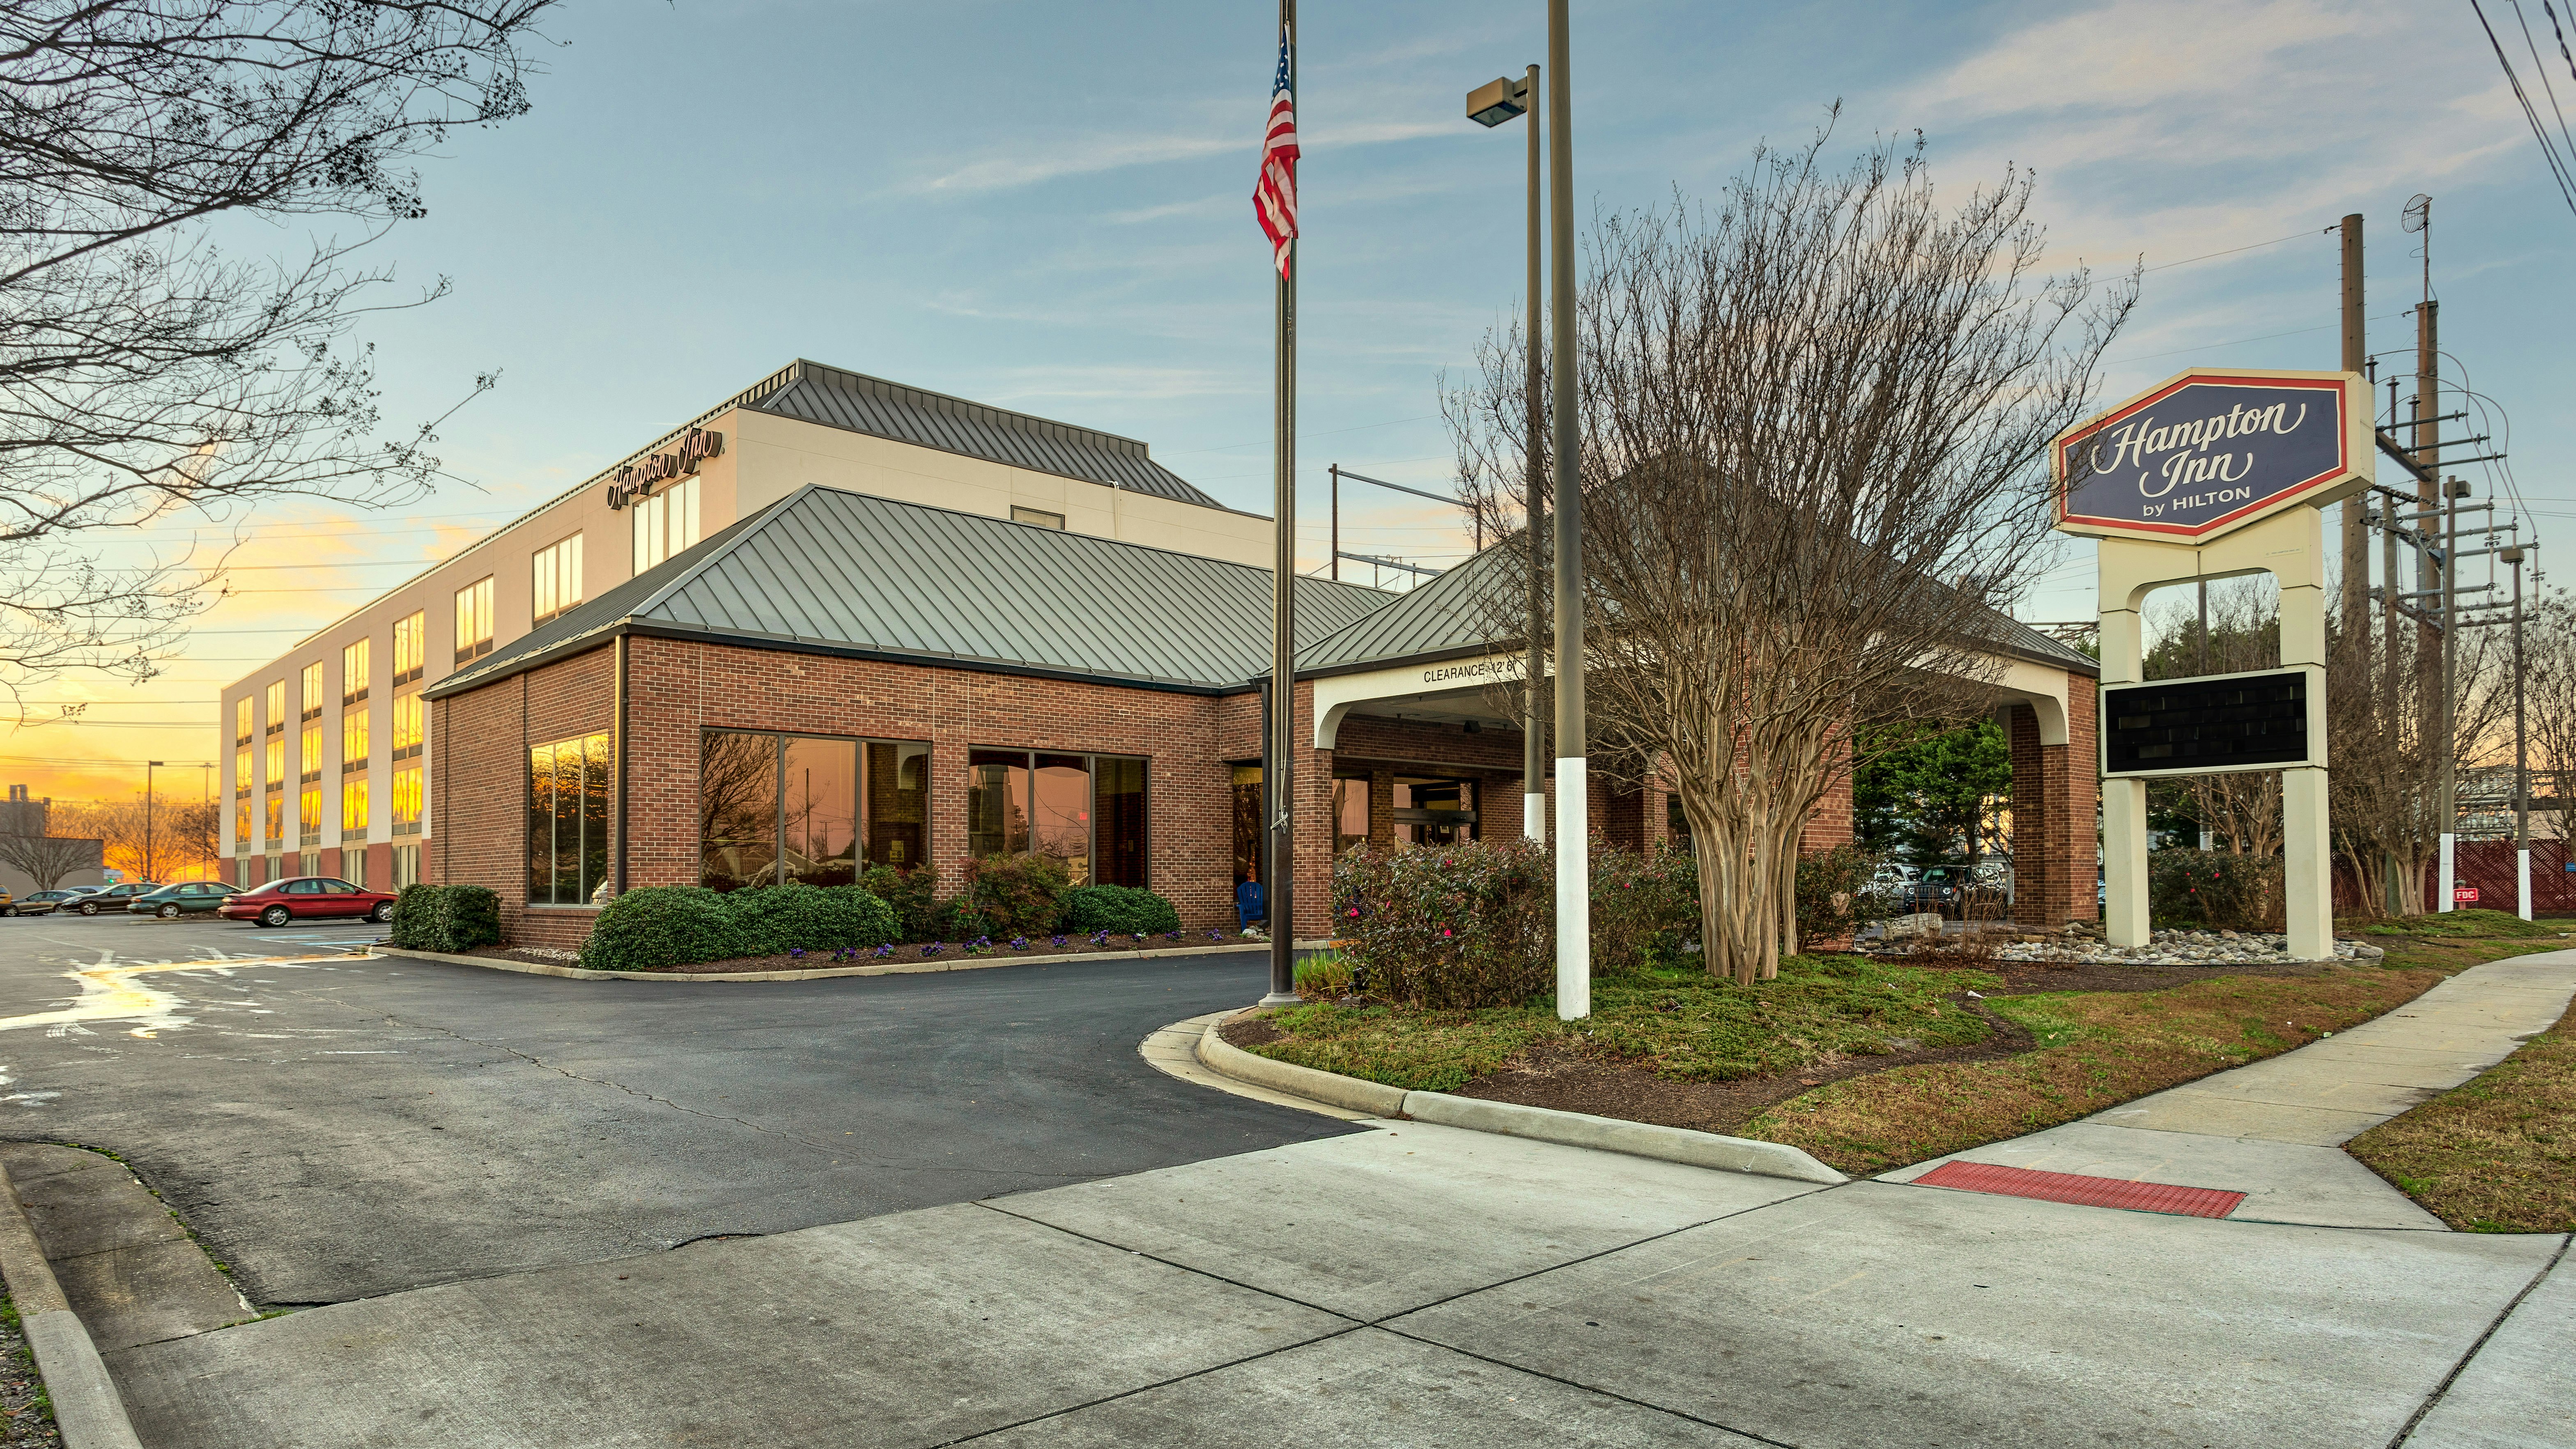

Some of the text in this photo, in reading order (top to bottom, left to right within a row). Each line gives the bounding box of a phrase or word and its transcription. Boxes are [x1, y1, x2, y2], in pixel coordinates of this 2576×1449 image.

[2091, 403, 2306, 475] Hampton
[607, 427, 714, 509] Hampton Inn
[2139, 449, 2253, 498] Inn
[2143, 486, 2250, 517] by HILTON
[1424, 664, 1484, 682] CLEARANCE
